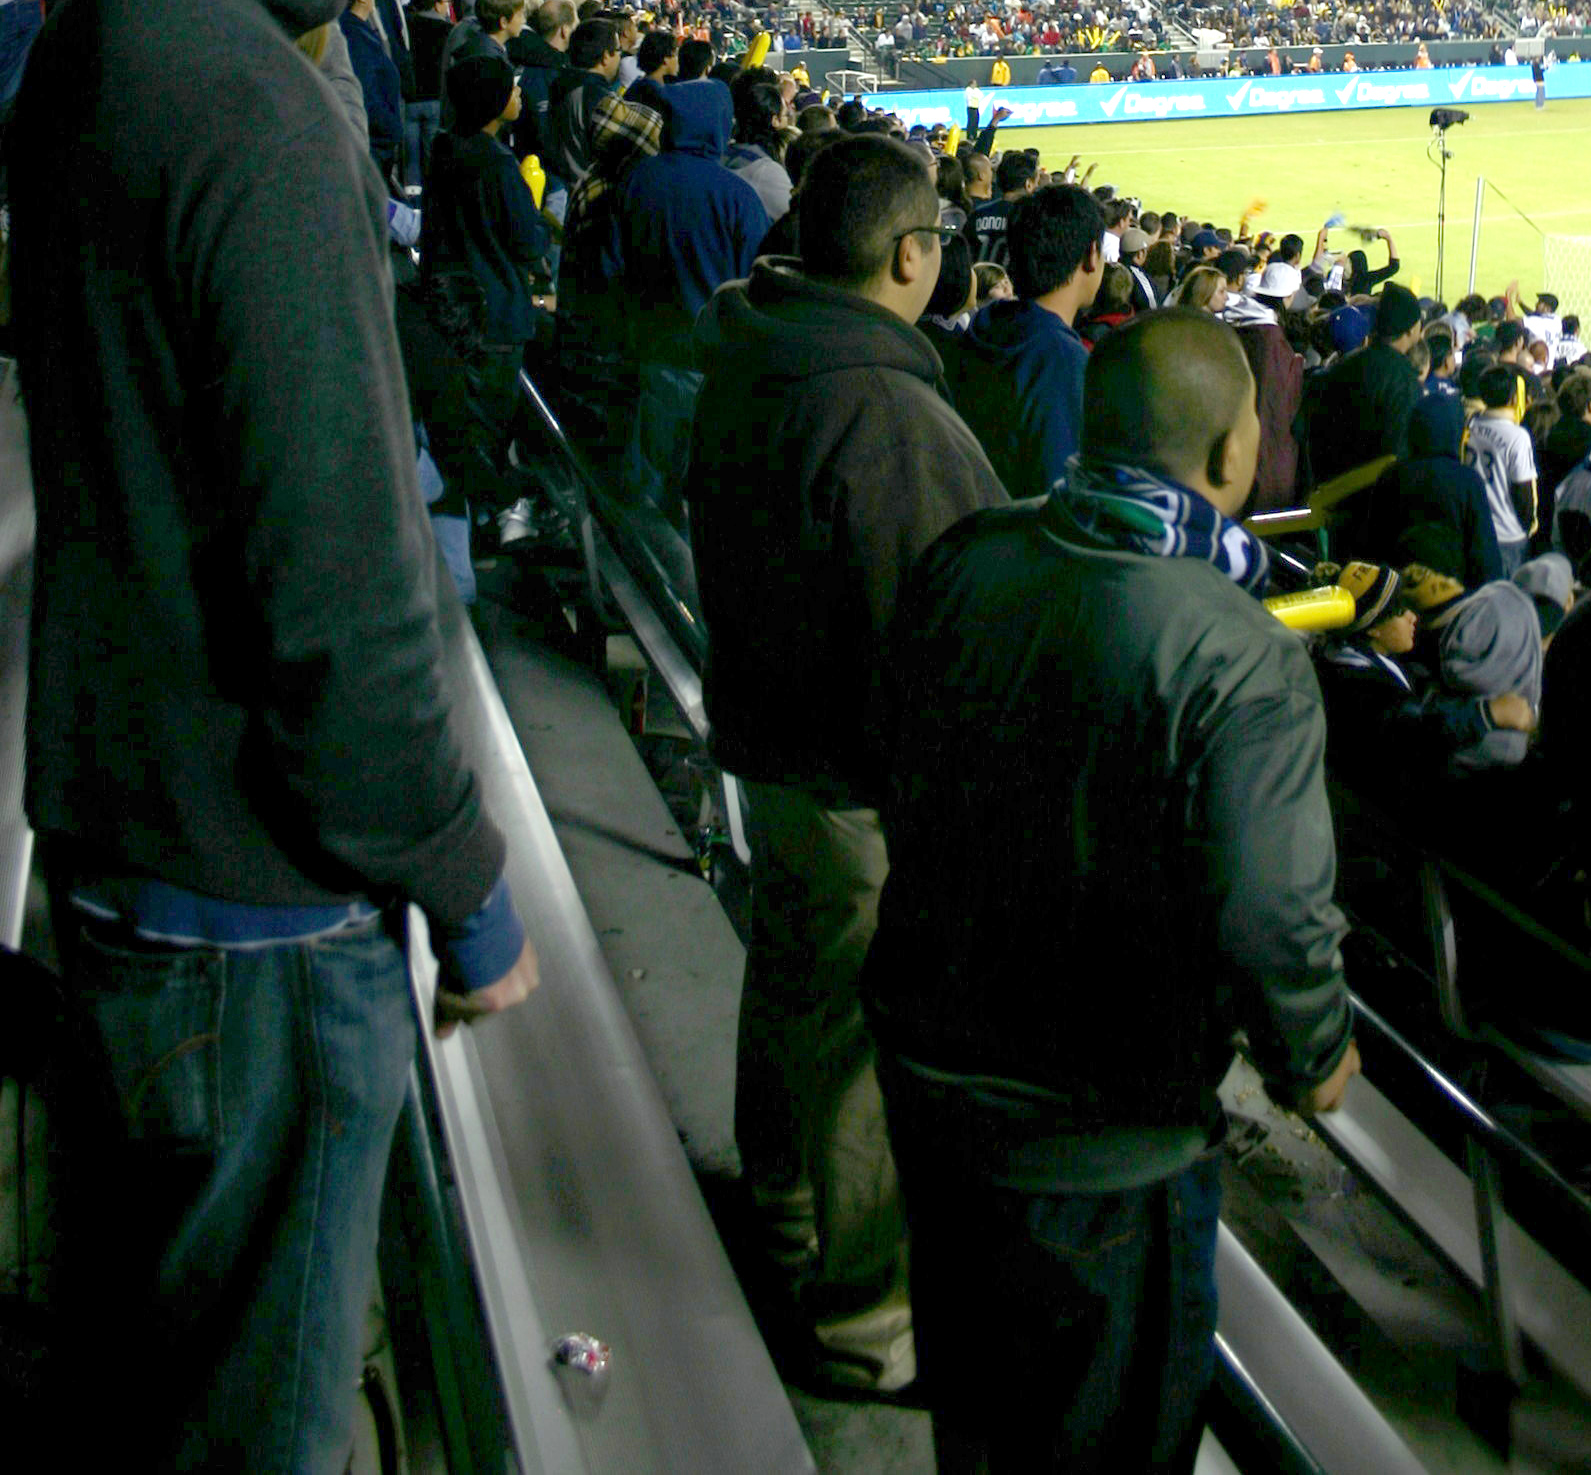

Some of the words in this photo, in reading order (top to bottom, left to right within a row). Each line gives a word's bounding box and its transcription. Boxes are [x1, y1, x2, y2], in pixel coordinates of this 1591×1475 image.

[1123, 93, 1208, 118] Degree
[1249, 86, 1326, 111] Degree
[1356, 81, 1433, 106] Degree
